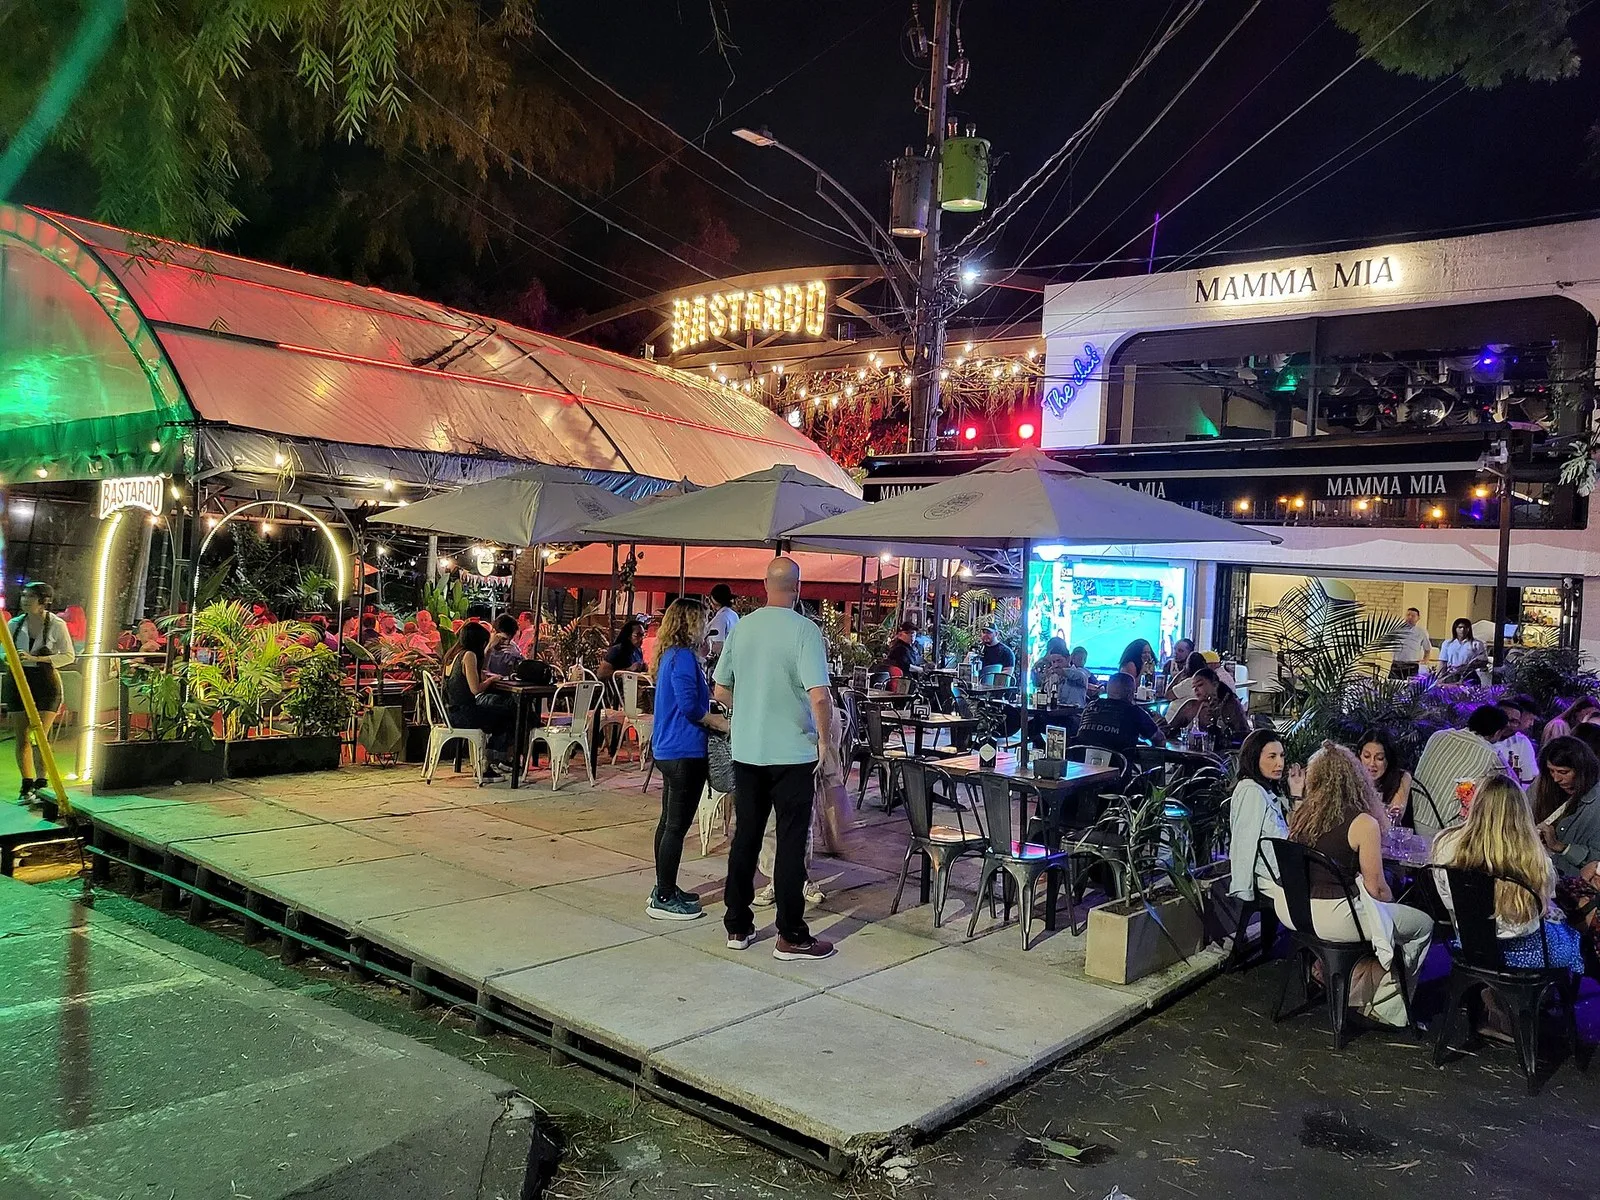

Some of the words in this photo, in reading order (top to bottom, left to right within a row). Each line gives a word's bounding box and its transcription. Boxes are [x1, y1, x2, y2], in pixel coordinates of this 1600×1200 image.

[1195, 267, 1317, 303] MAMMA
[1333, 256, 1394, 289] MIA
[673, 280, 827, 352] BASTARDO
[1046, 383, 1075, 417] The
[102, 479, 161, 516] BASTARDO
[879, 485, 923, 500] MAM
[1138, 482, 1166, 499] MIA
[1326, 476, 1402, 496] MAMMA
[1409, 474, 1447, 494] MIA
